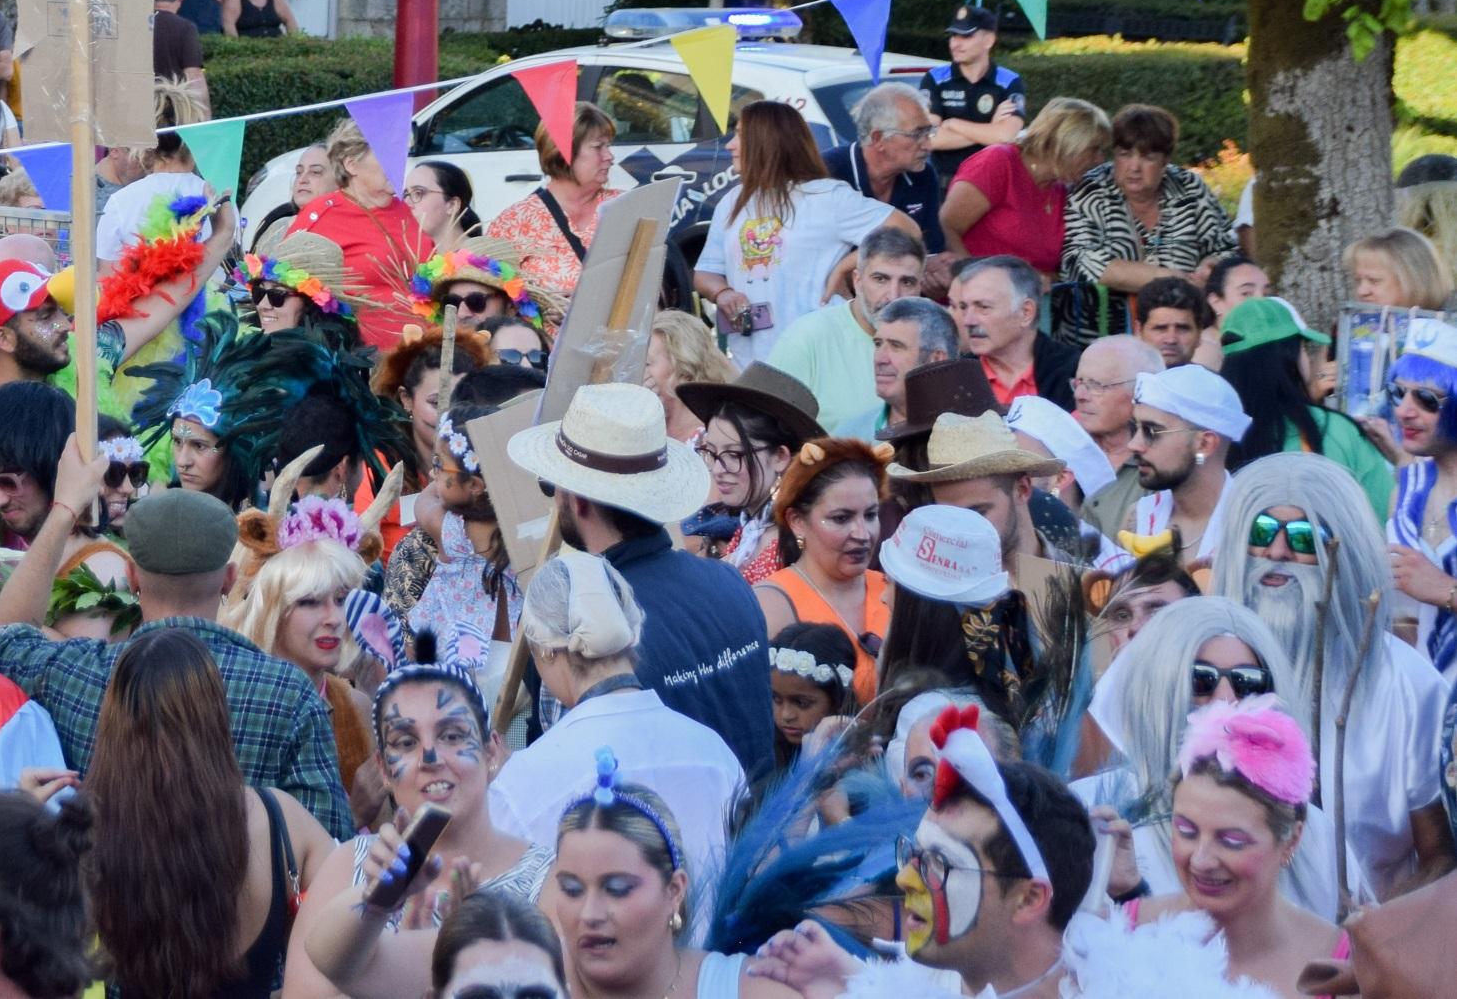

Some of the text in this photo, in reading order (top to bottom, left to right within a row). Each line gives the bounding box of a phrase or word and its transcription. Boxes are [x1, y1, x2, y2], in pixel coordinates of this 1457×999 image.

[669, 197, 694, 228] IA
[922, 526, 968, 549] Comercial
[663, 640, 760, 687] Making the difference
